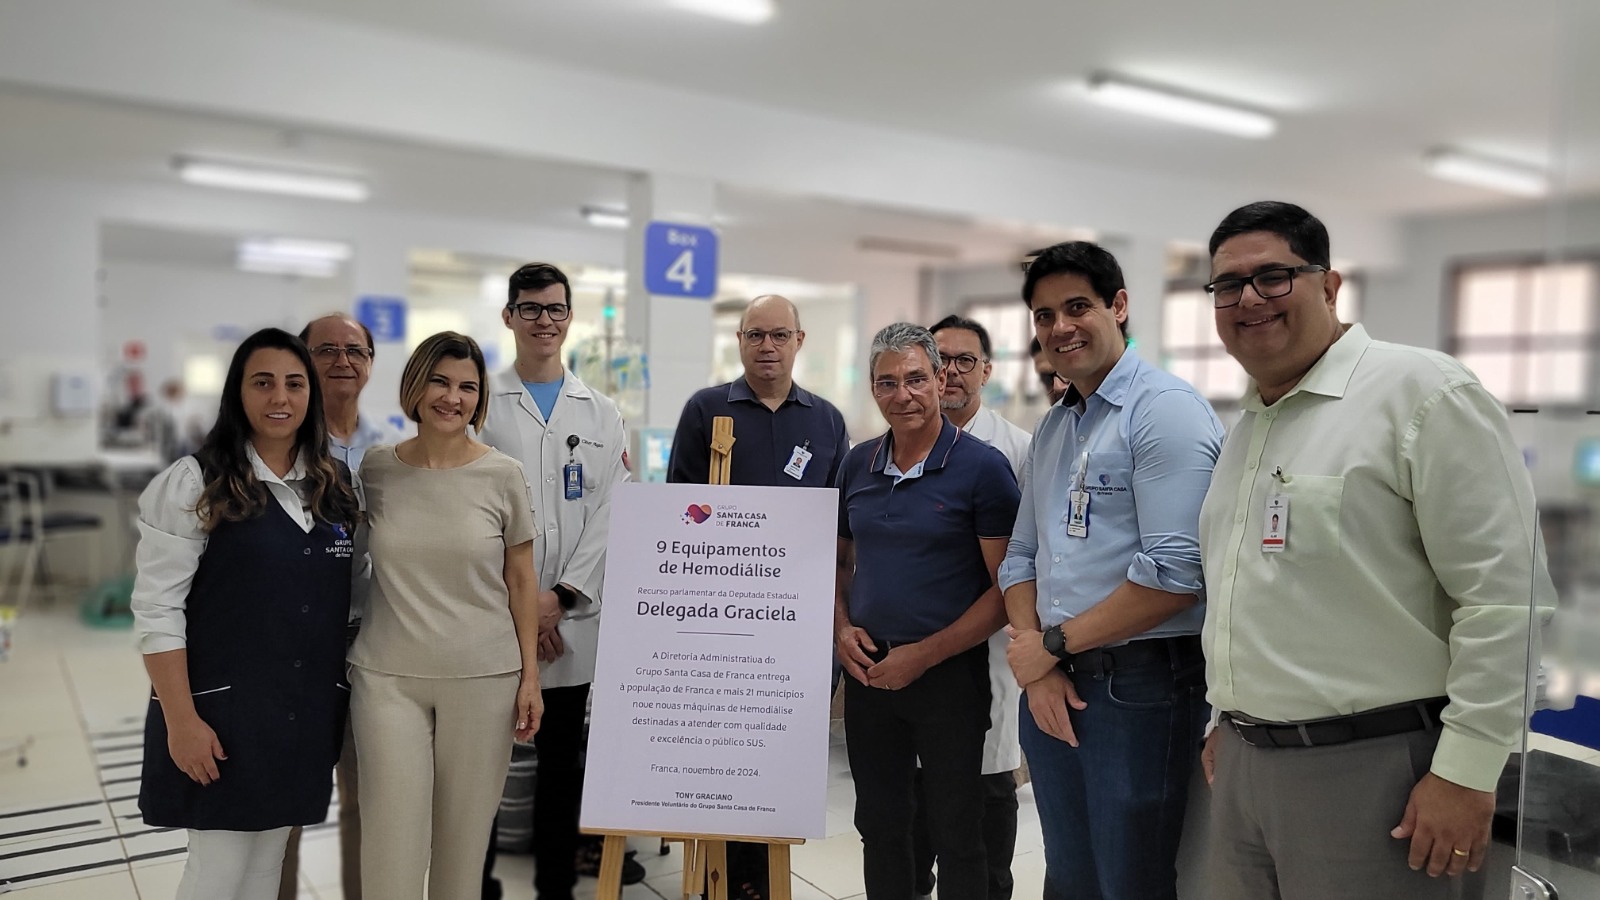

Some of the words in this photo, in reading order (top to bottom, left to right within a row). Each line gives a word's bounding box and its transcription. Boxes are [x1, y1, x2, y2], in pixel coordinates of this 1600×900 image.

[667, 229, 698, 246] Box
[666, 251, 697, 291] 4
[716, 511, 744, 520] SANTA
[744, 512, 767, 520] CASA
[725, 520, 760, 529] FRANCA
[656, 540, 667, 554] 9
[671, 540, 786, 560] Equipamentos
[658, 559, 678, 575] de
[682, 561, 782, 578] Hemodiálise
[637, 586, 669, 595] Recurso
[669, 588, 717, 598] parlamentar
[717, 589, 728, 598] da
[728, 590, 765, 600] Deputada
[766, 591, 799, 600] Estadual
[637, 601, 719, 622] Delegada
[724, 604, 797, 622] Graciela
[651, 651, 659, 660] A
[660, 651, 698, 661] Diretoria
[699, 653, 763, 664] Administrativa
[764, 655, 776, 665] do
[635, 666, 663, 678] Grupo
[664, 668, 689, 677] Santa
[690, 669, 712, 678] Casa
[713, 670, 724, 679] de
[725, 670, 755, 680] Franca
[756, 672, 791, 684] entrega
[619, 682, 625, 691] à
[626, 683, 671, 695] população
[672, 684, 684, 694] de
[685, 685, 715, 695] Franca
[716, 688, 722, 696] e
[723, 687, 745, 696] mais
[745, 688, 754, 697] 21
[756, 689, 805, 700] municípios
[632, 701, 654, 709] nove
[655, 702, 682, 710] novas
[683, 702, 726, 714] máquinas
[727, 703, 739, 713] de
[739, 704, 793, 715] Hemodiálise
[631, 716, 679, 727] destinadas
[687, 719, 722, 729] atender
[723, 722, 743, 730] com
[744, 721, 787, 732] qualidade
[649, 735, 656, 743] e
[656, 735, 703, 745] excelência
[712, 737, 745, 748] público
[746, 738, 766, 748] SUS.
[650, 763, 681, 774] Franca,
[682, 766, 724, 776] novembro
[725, 767, 736, 776] de
[737, 767, 761, 777] 2024.
[675, 791, 695, 800] TONY
[695, 792, 733, 802] GRACIANO
